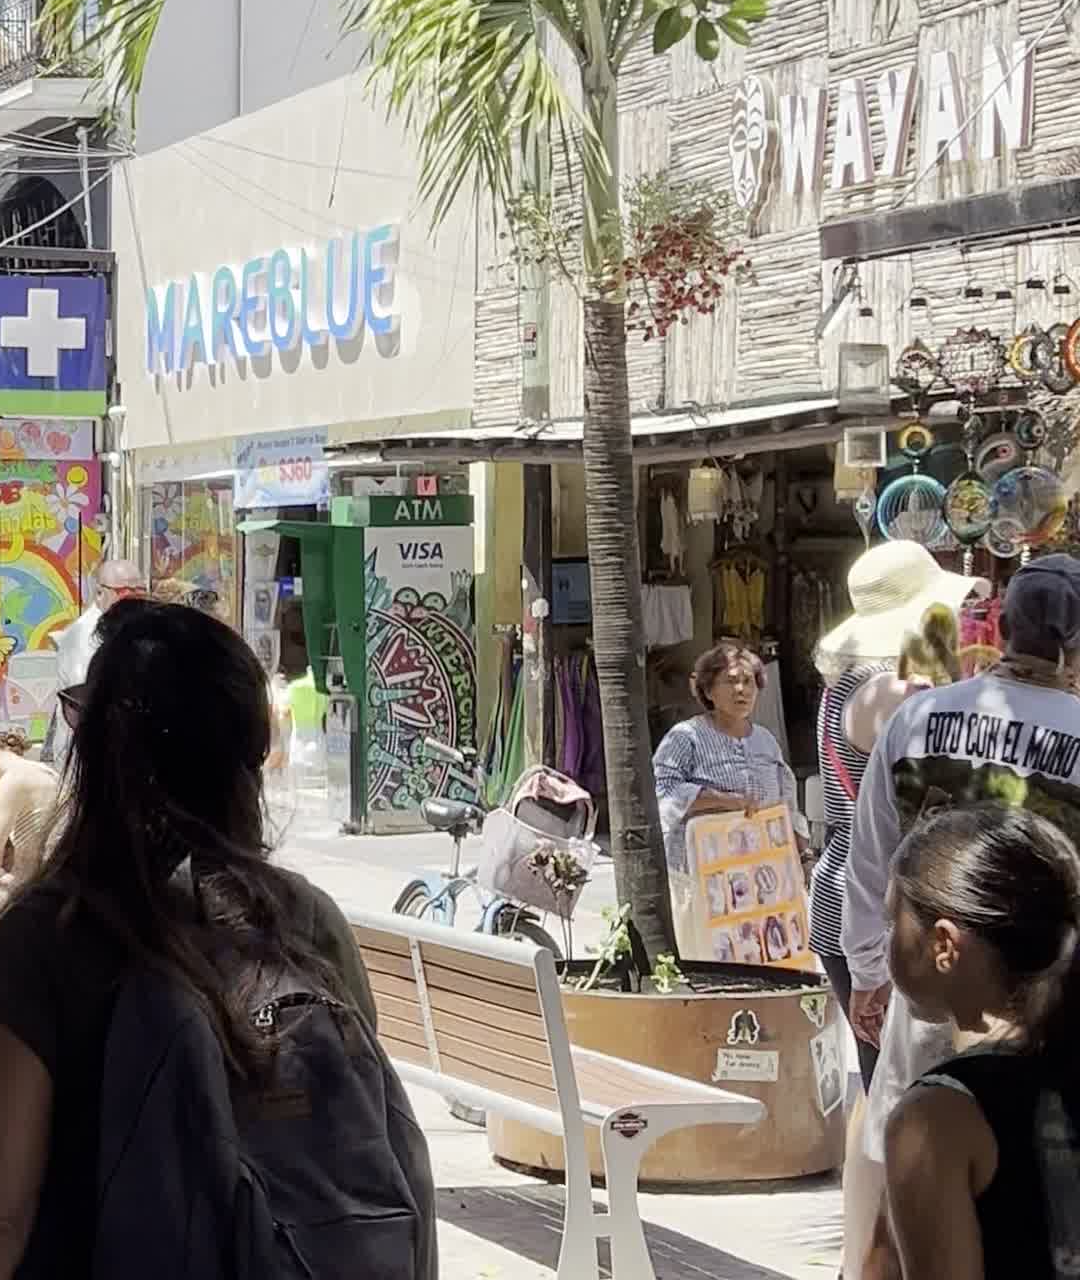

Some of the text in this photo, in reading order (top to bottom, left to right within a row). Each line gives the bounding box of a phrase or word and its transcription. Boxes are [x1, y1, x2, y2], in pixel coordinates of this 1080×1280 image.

[779, 39, 1033, 195] WAYAN
[146, 222, 397, 376] MAREBLUE
[394, 499, 443, 521] ATM
[399, 542, 444, 560] VISA
[925, 711, 965, 754] FOTO
[966, 713, 1003, 760] CON
[1001, 720, 1025, 764] EL
